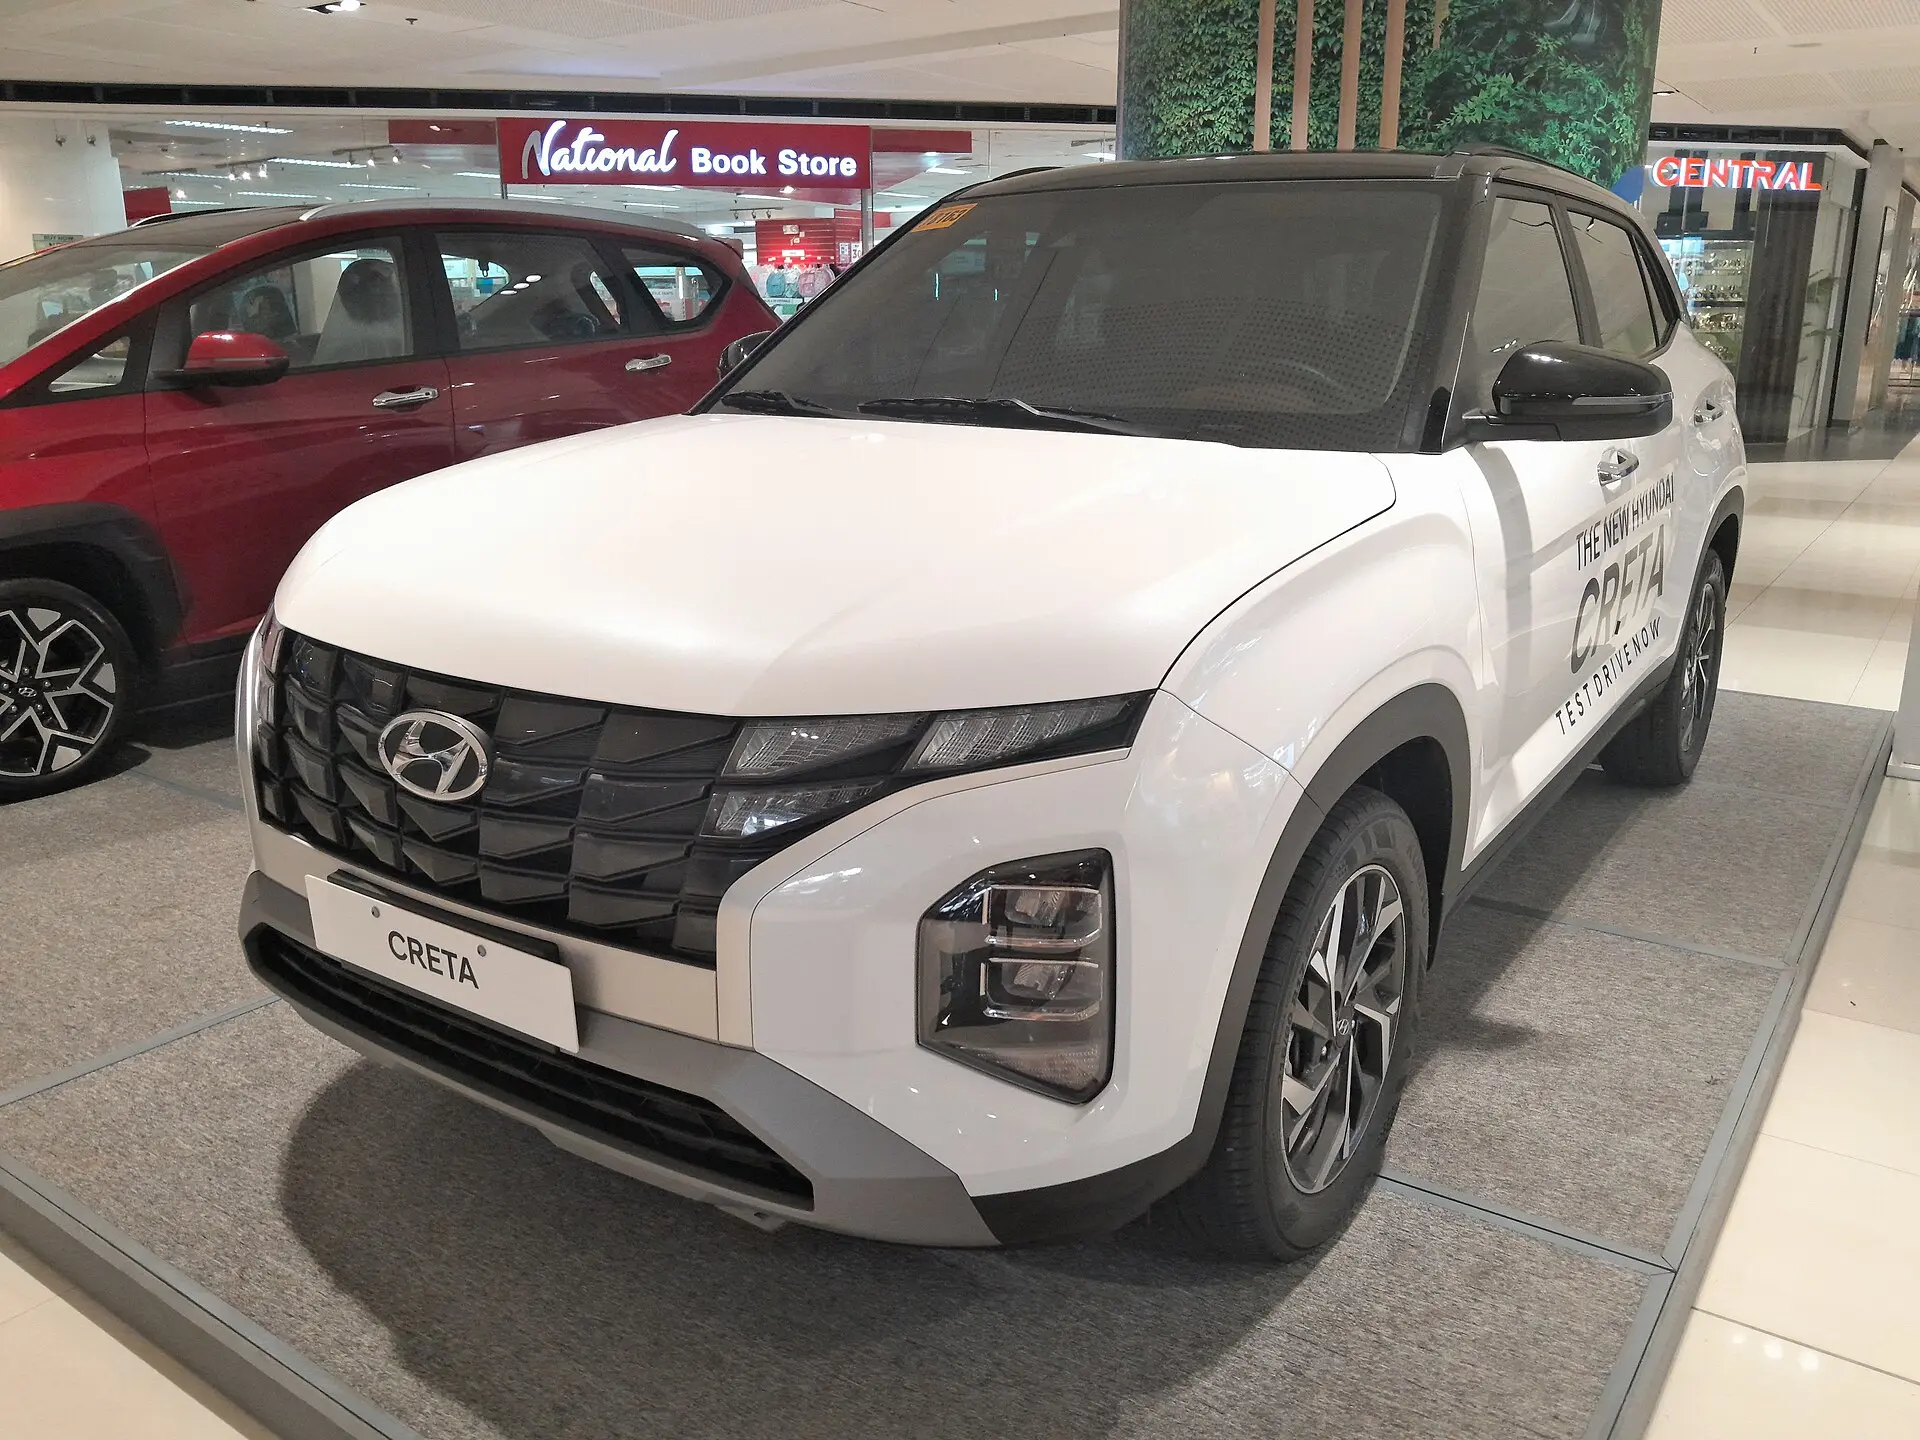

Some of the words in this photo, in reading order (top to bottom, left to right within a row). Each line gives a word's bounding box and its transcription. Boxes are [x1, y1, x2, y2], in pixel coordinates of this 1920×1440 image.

[521, 119, 679, 180] National
[690, 147, 767, 176] Book
[778, 148, 857, 177] Store
[1652, 155, 1824, 191] CENTRAL
[1576, 521, 1601, 571] THE
[1603, 506, 1631, 552] NEW
[1632, 472, 1674, 528] HYUNDAI
[1570, 524, 1664, 674] CRETA
[1555, 685, 1592, 735] TEST
[1593, 645, 1632, 697] DRIVE
[1632, 617, 1660, 656] NOW
[388, 930, 479, 989] CRETA
